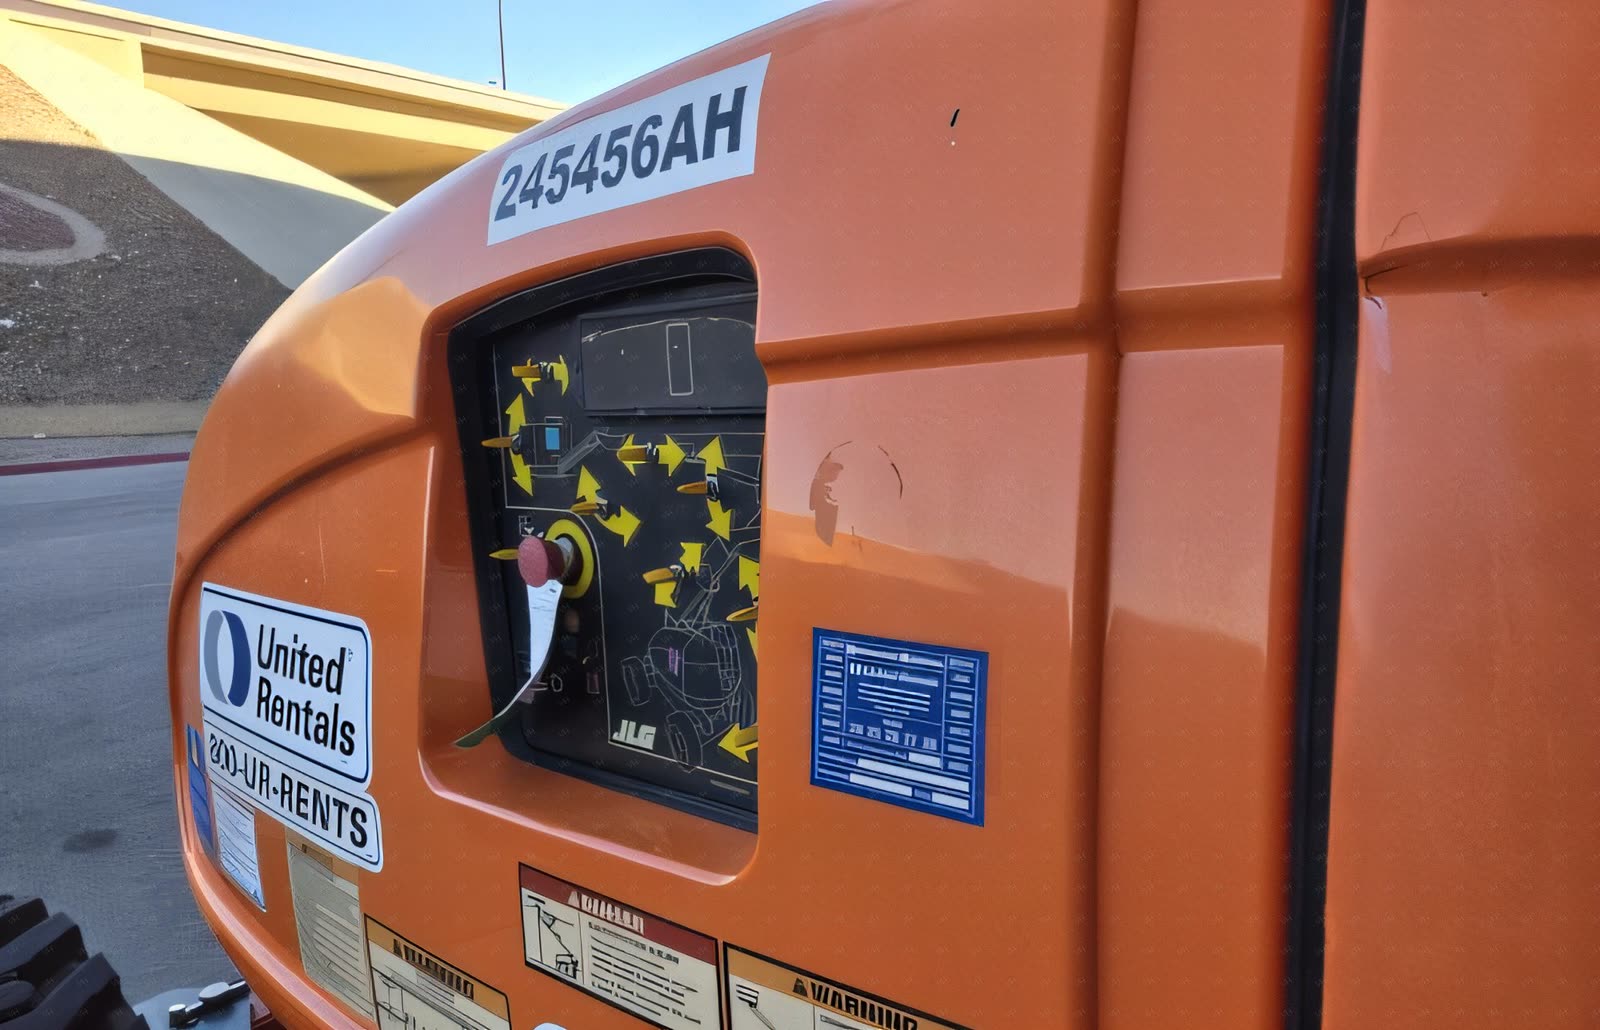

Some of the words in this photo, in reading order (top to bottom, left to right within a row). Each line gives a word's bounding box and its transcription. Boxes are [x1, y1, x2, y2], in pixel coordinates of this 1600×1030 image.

[494, 86, 748, 222] 245456AH
[257, 624, 346, 695] United
[256, 676, 355, 757] Rentals
[612, 719, 656, 750] JLG
